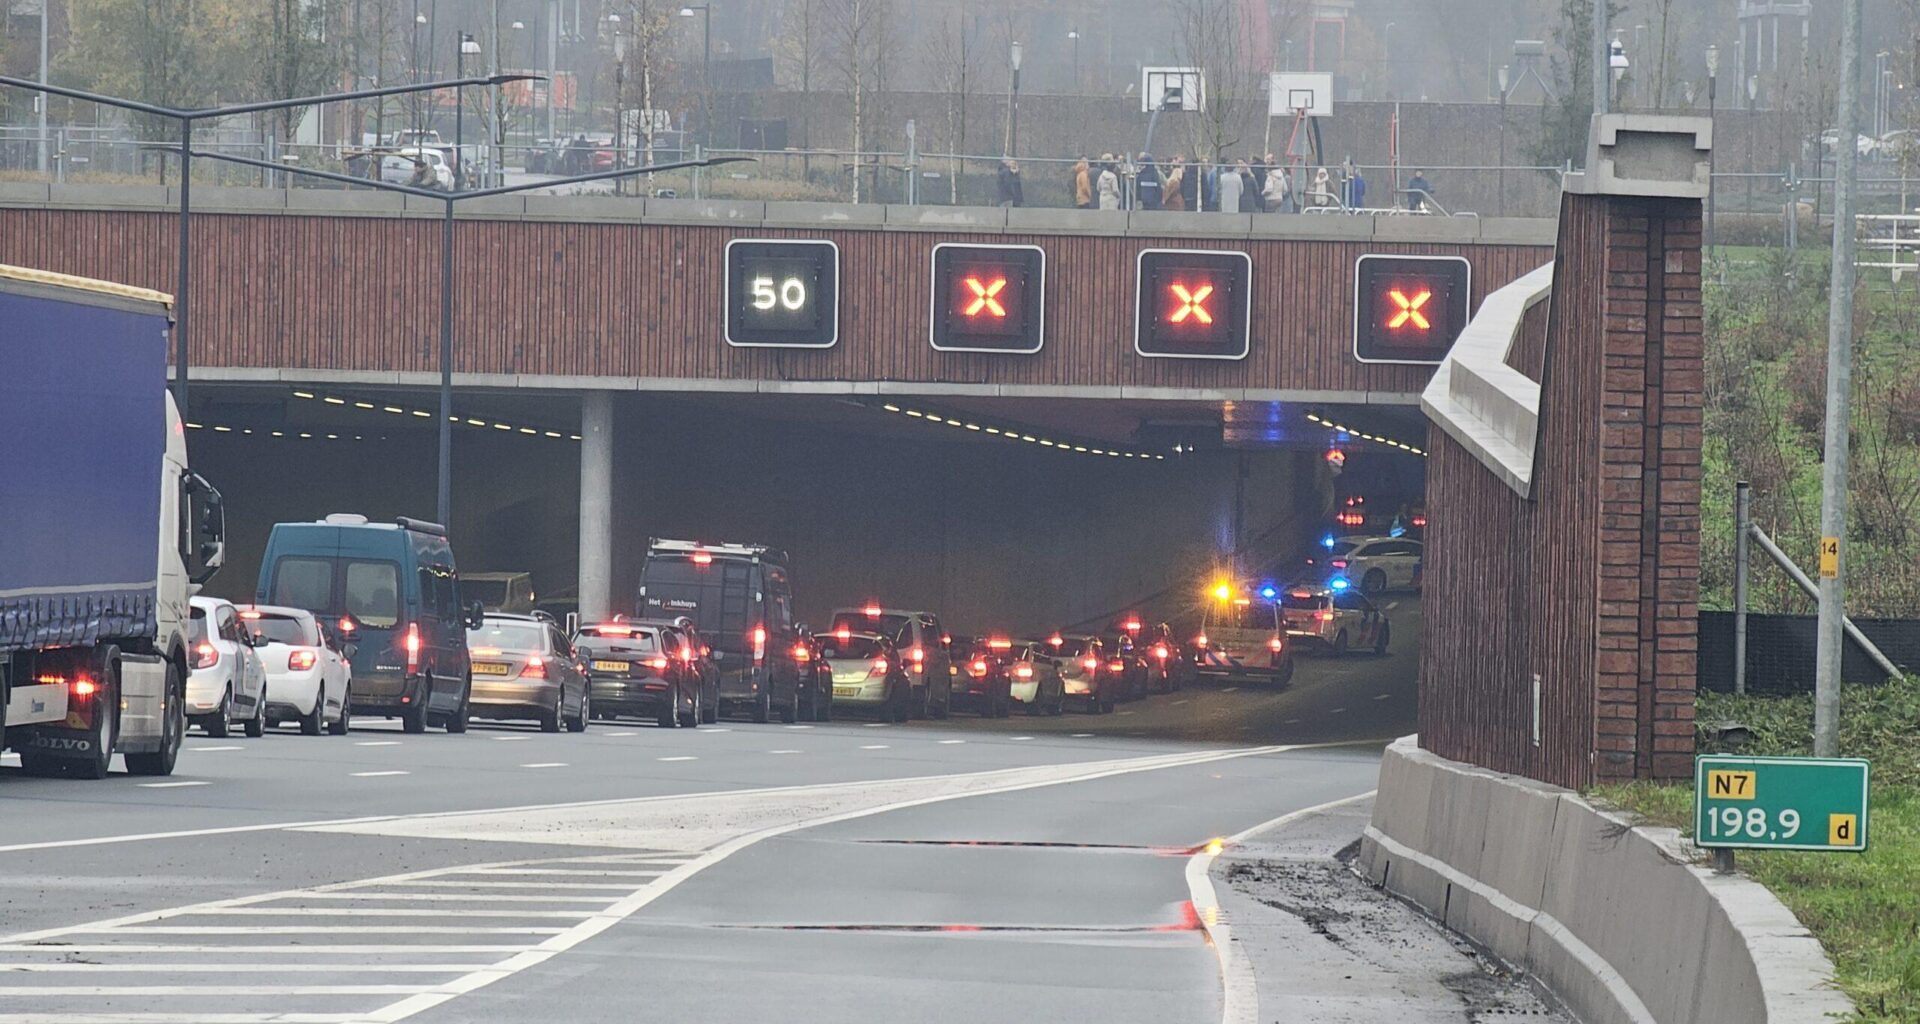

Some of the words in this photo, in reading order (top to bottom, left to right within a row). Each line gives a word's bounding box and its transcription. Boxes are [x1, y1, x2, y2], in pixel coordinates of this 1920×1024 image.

[752, 277, 806, 310] 50
[1822, 541, 1837, 556] 14
[1716, 774, 1748, 795] N7
[1708, 807, 1801, 840] 198,9
[1837, 820, 1850, 840] d
